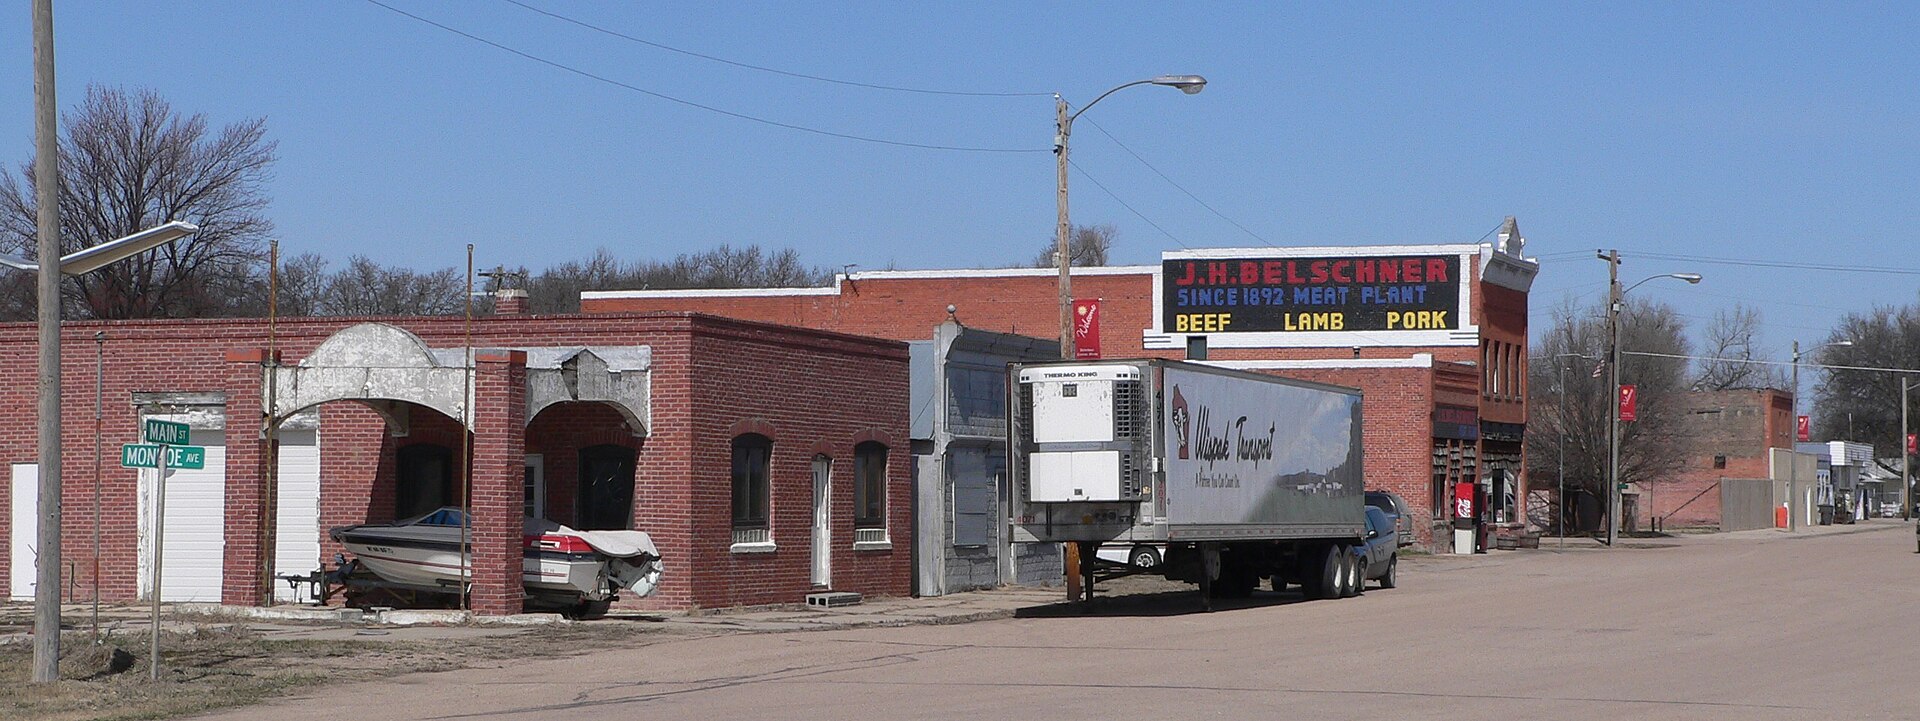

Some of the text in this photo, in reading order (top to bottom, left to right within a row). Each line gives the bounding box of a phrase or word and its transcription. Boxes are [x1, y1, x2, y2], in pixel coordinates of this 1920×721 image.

[1177, 284, 1427, 307] SINCE 1892 MEAT PLANT
[1176, 310, 1448, 332] BEEF LAMB PORK
[149, 422, 187, 443] MAIN ST
[1235, 416, 1276, 471] Transport
[126, 447, 200, 467] MONOE AVE
